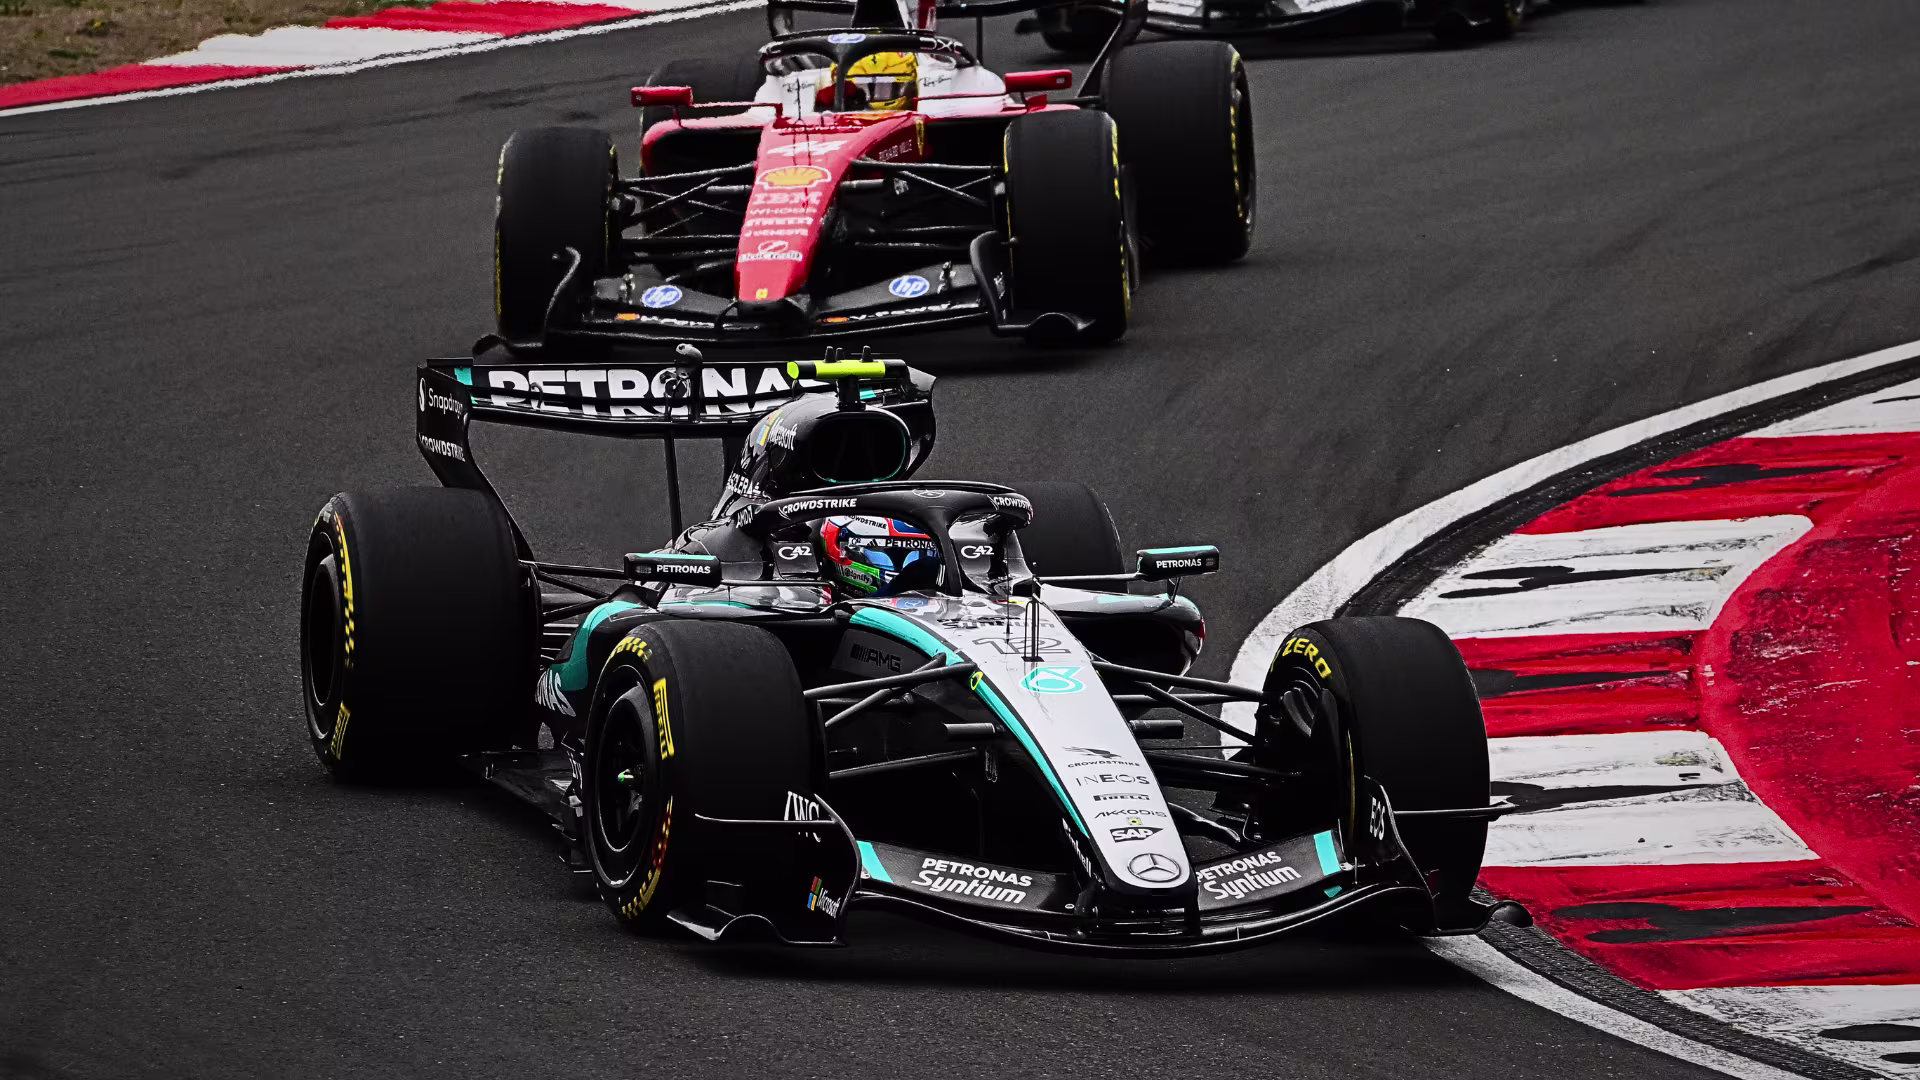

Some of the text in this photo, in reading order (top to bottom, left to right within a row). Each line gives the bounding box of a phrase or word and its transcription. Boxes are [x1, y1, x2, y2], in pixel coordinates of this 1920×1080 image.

[752, 191, 823, 205] IBM
[488, 365, 830, 417] PETRONA
[781, 498, 858, 515] CROWDSTRIKE
[848, 515, 888, 529] OWDSTRIKE
[778, 546, 813, 560] G42
[960, 545, 995, 559] G42
[656, 564, 711, 574] PETRONAS
[1156, 558, 1202, 569] PETRONAS
[971, 637, 1072, 655] 12
[867, 648, 901, 674] AMG
[1282, 638, 1333, 679] ZERO
[1067, 760, 1141, 768] CROWDSTRIKE
[1075, 773, 1151, 787] INEOS
[1092, 792, 1151, 802] PIRELLI
[1112, 828, 1154, 841] SAP
[921, 857, 1034, 888] PETRONAS
[1195, 851, 1283, 883] PETRONAS
[910, 869, 1027, 905] Syntium
[1203, 866, 1303, 900] Syntium
